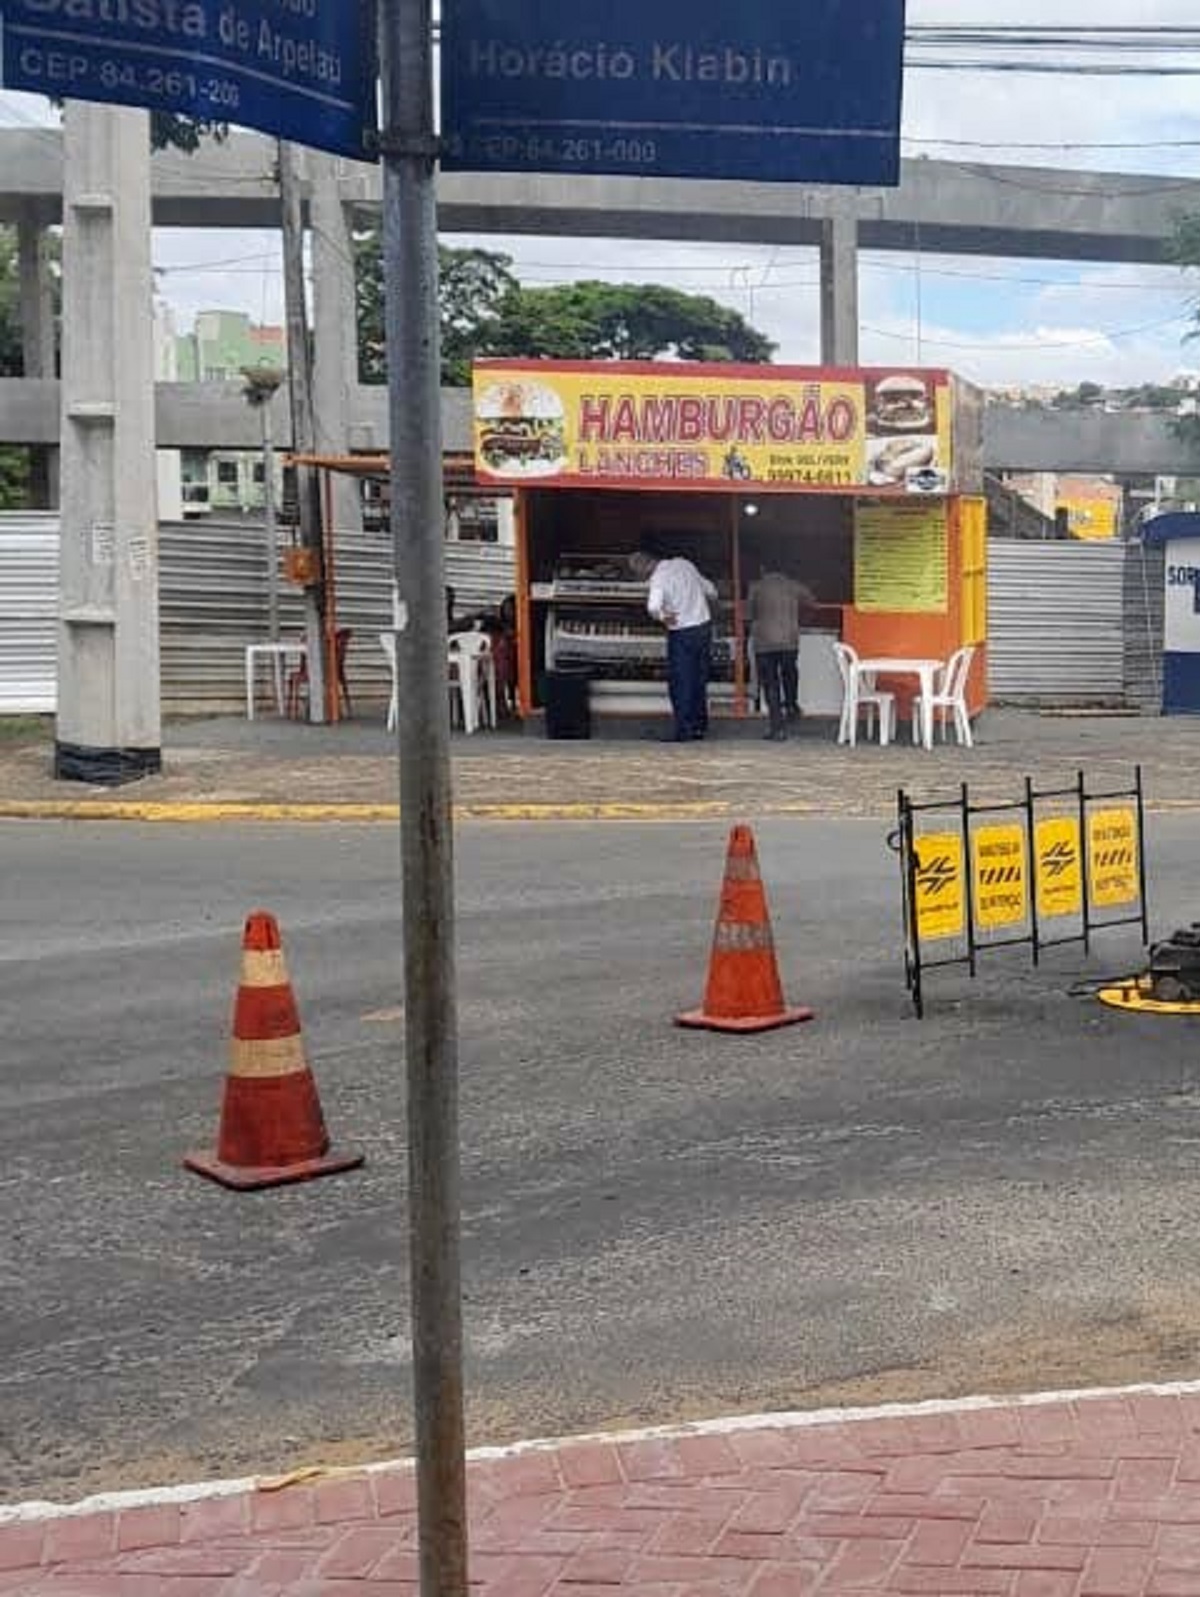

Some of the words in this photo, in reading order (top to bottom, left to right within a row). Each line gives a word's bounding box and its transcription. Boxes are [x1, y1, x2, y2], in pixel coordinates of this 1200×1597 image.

[219, 4, 249, 50] de
[469, 38, 634, 79] Horácio
[652, 42, 792, 86] Klabin
[579, 384, 857, 443] HAMBURGÃO
[578, 450, 709, 478] LANCHES
